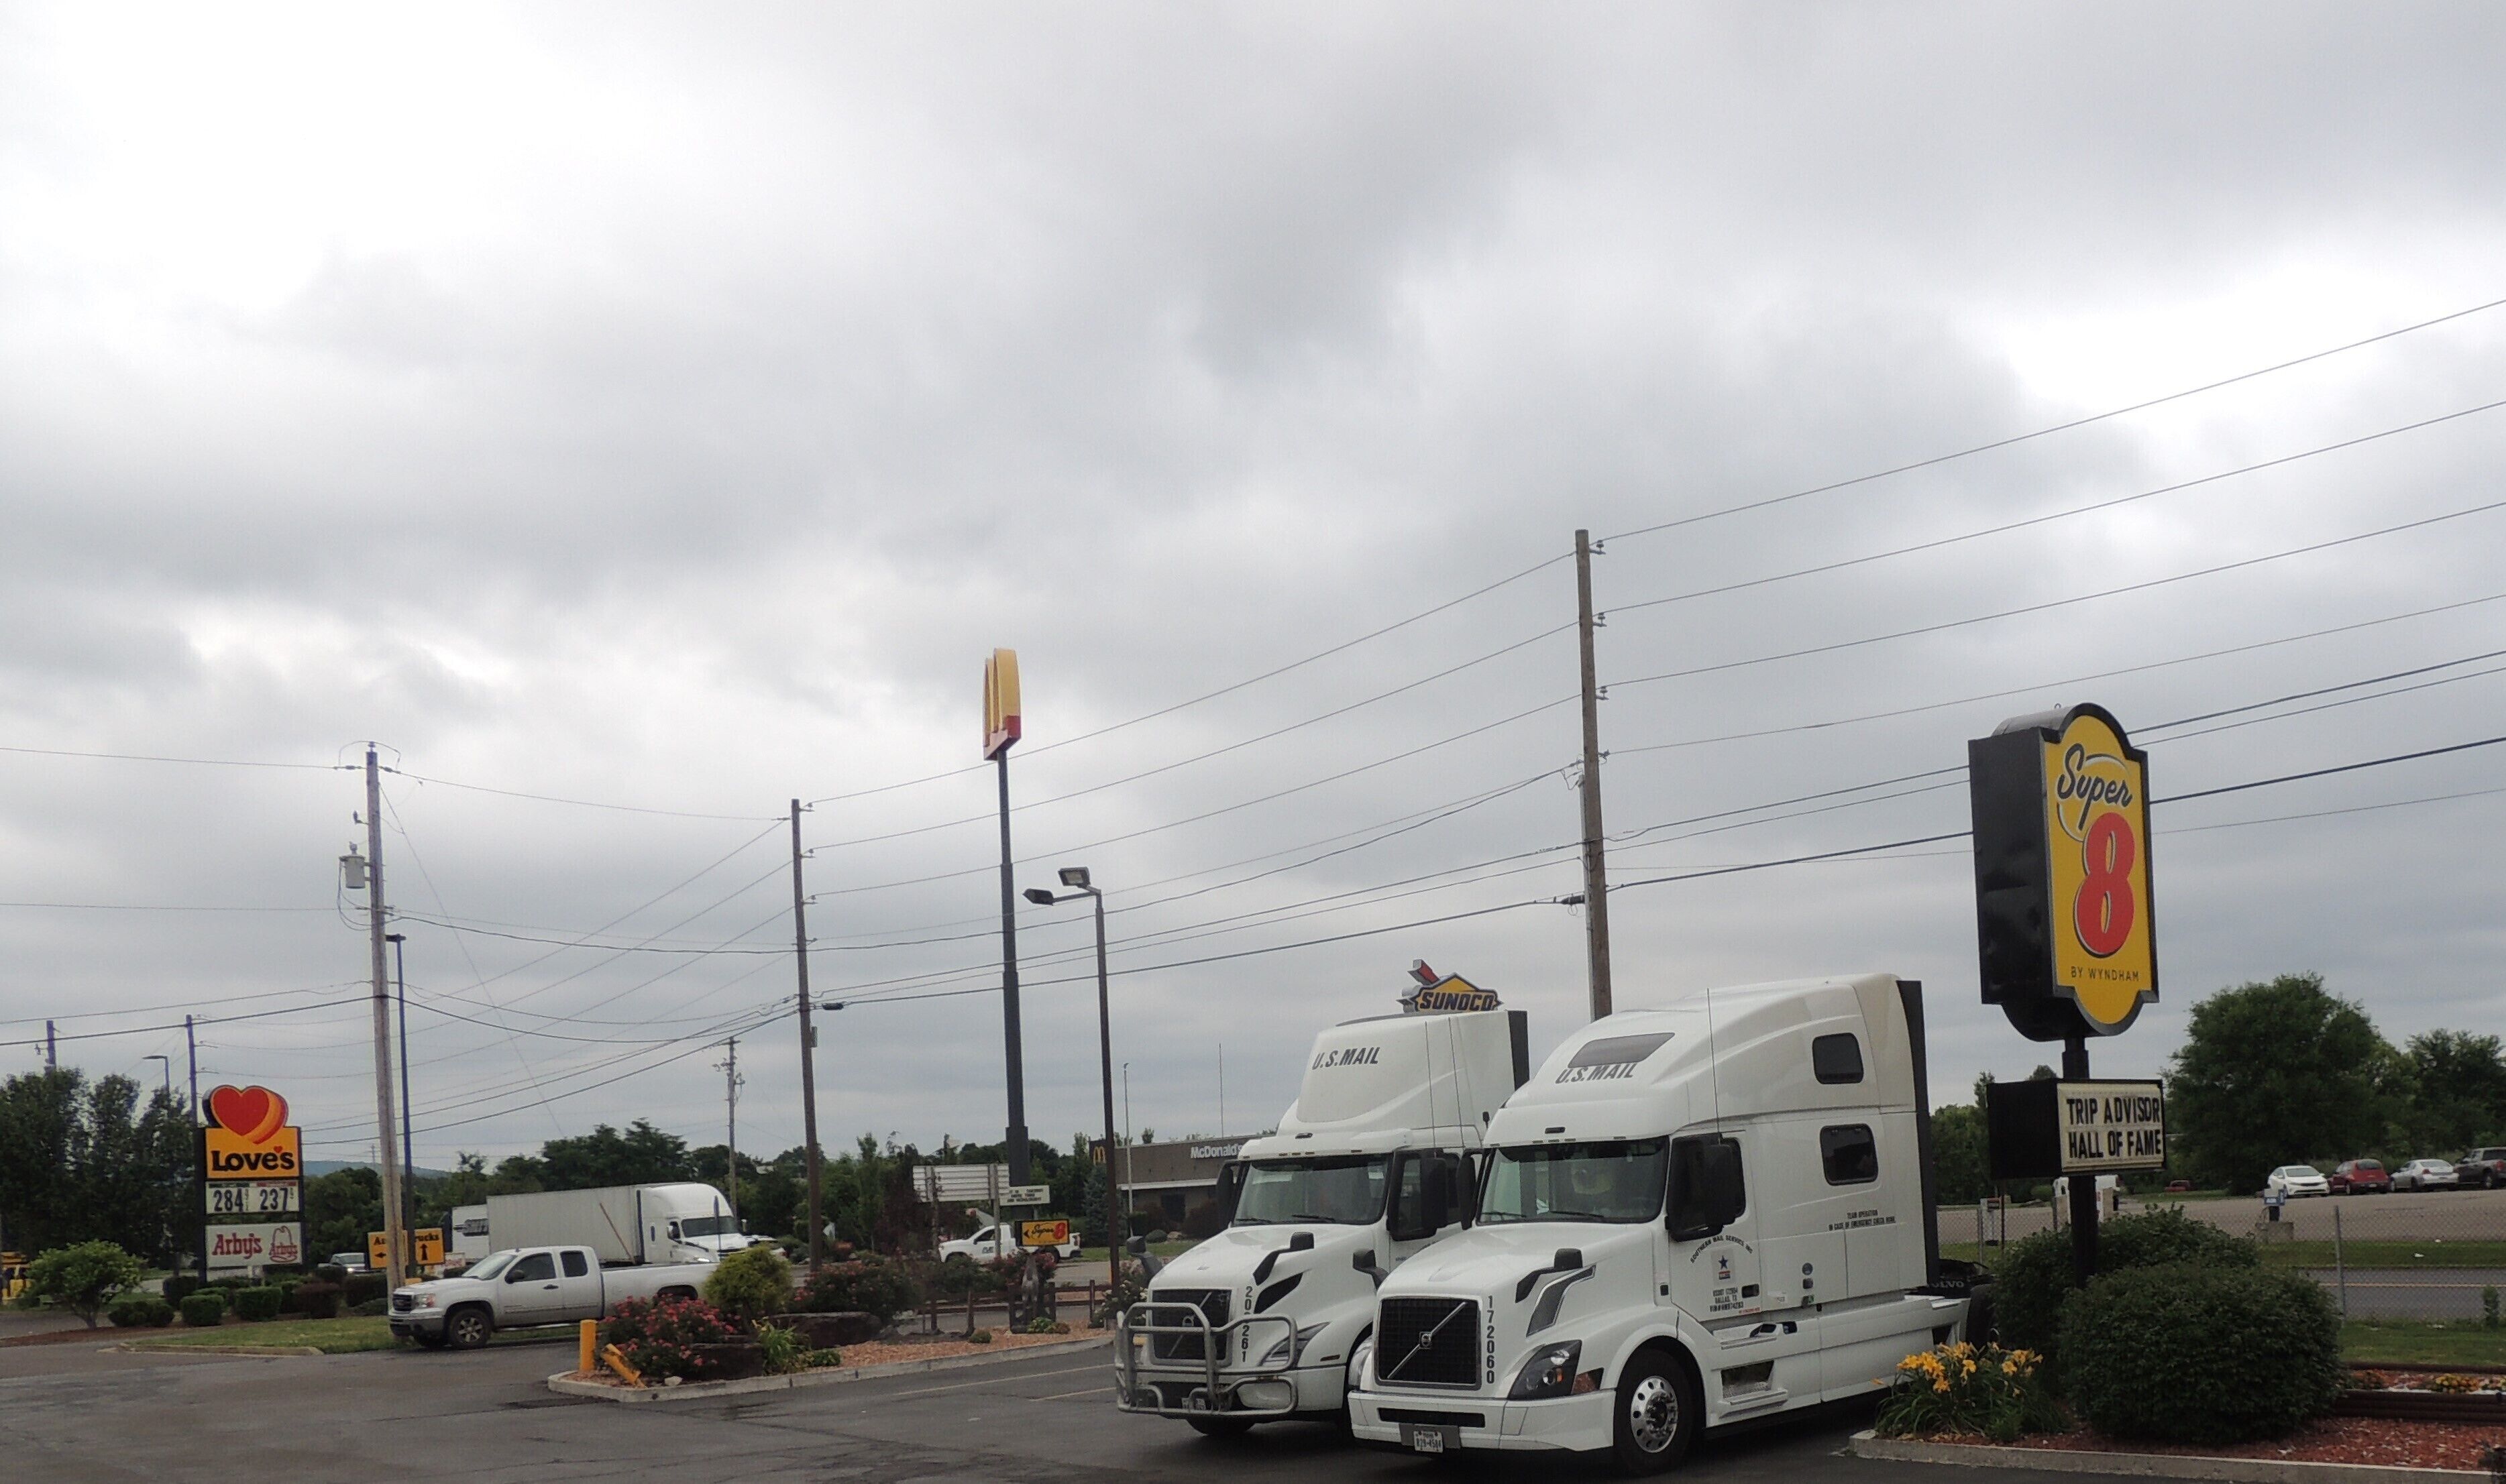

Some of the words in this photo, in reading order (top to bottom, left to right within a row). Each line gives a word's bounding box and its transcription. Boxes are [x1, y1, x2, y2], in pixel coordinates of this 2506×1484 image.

[2057, 742, 2132, 831] Super
[2073, 812, 2136, 958] 8
[2071, 966, 2083, 978] BY
[2088, 968, 2140, 982] WYNDHAM
[1419, 991, 1494, 1011] SUNOCO
[2066, 1098, 2098, 1125] TRIP
[2104, 1096, 2161, 1124] ADVISOR
[2069, 1131, 2104, 1159] HALL
[2108, 1130, 2124, 1157] OF
[2127, 1129, 2162, 1157] FAME
[211, 1146, 295, 1172] Love's
[213, 1188, 243, 1212] 284
[259, 1187, 288, 1212] 237
[415, 1233, 439, 1242] rucks
[1053, 1222, 1066, 1239] 8
[212, 1233, 263, 1260] Arby's
[1486, 1295, 1495, 1384] 172060
